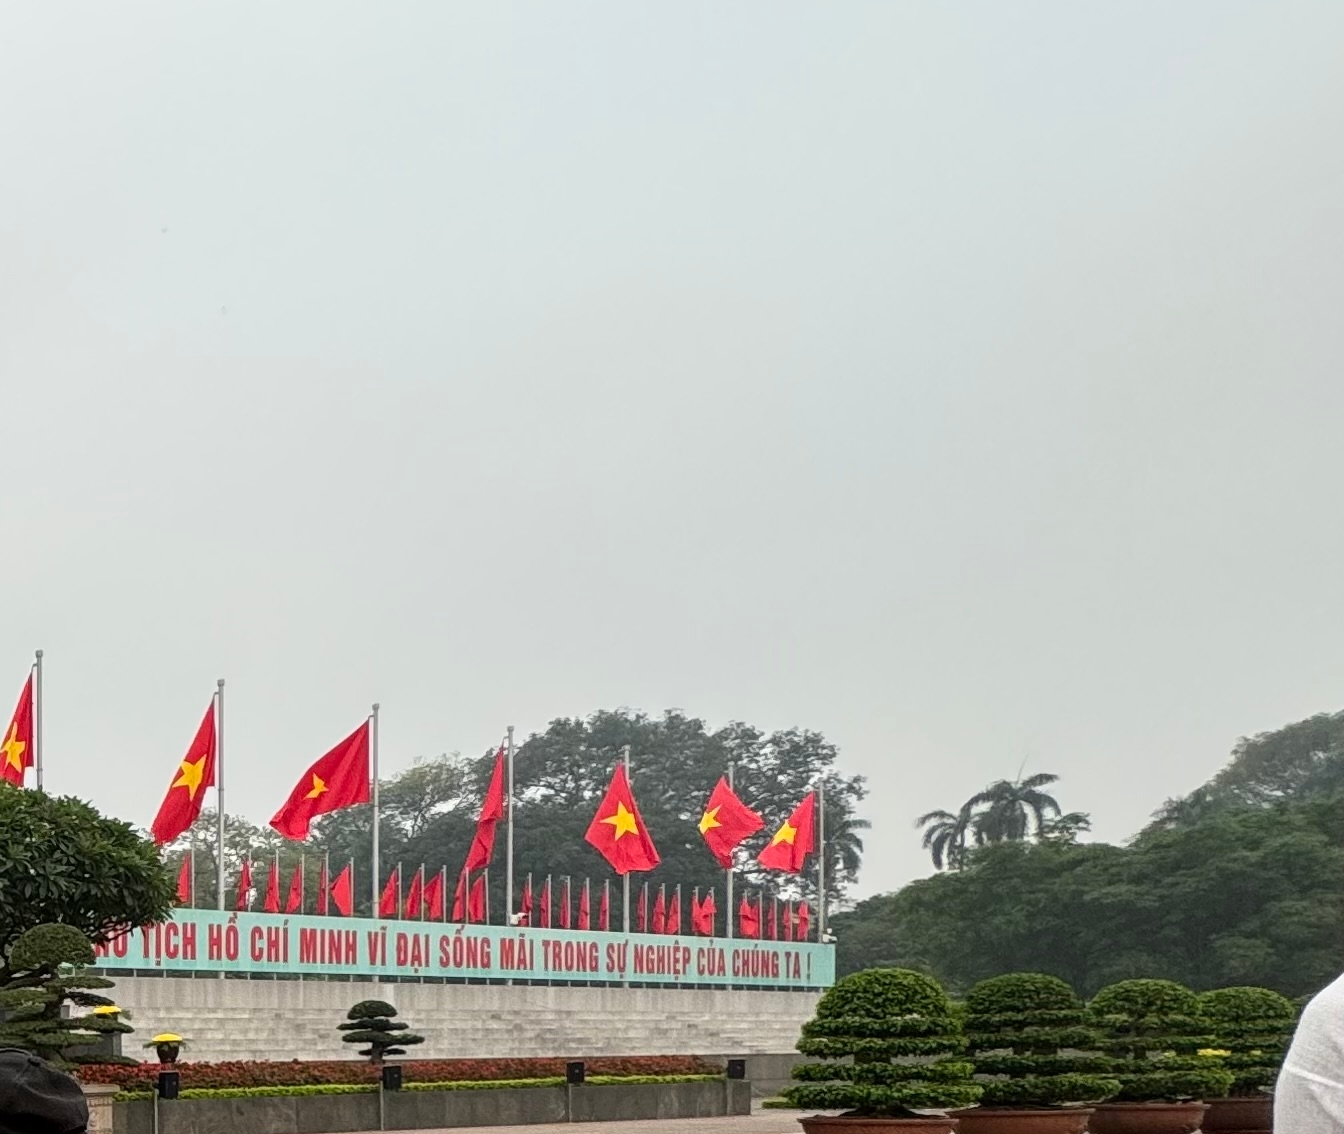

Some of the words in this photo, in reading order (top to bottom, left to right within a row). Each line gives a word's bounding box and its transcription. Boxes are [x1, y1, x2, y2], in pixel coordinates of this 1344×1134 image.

[140, 921, 196, 966] TỊCH
[208, 912, 239, 961] HỒ
[250, 919, 289, 963] CHÍ
[299, 928, 357, 965] MINH
[367, 926, 388, 966] VĨ
[396, 932, 430, 973] ĐẠI
[439, 925, 491, 969] SỐNG
[499, 933, 534, 970] MÃI
[542, 939, 599, 973] TRONG
[606, 939, 628, 979] SỰ
[633, 939, 691, 981] NGHIỆP
[697, 939, 726, 976] CỦA
[732, 943, 779, 978] CHÚNG
[785, 951, 801, 979] TA
